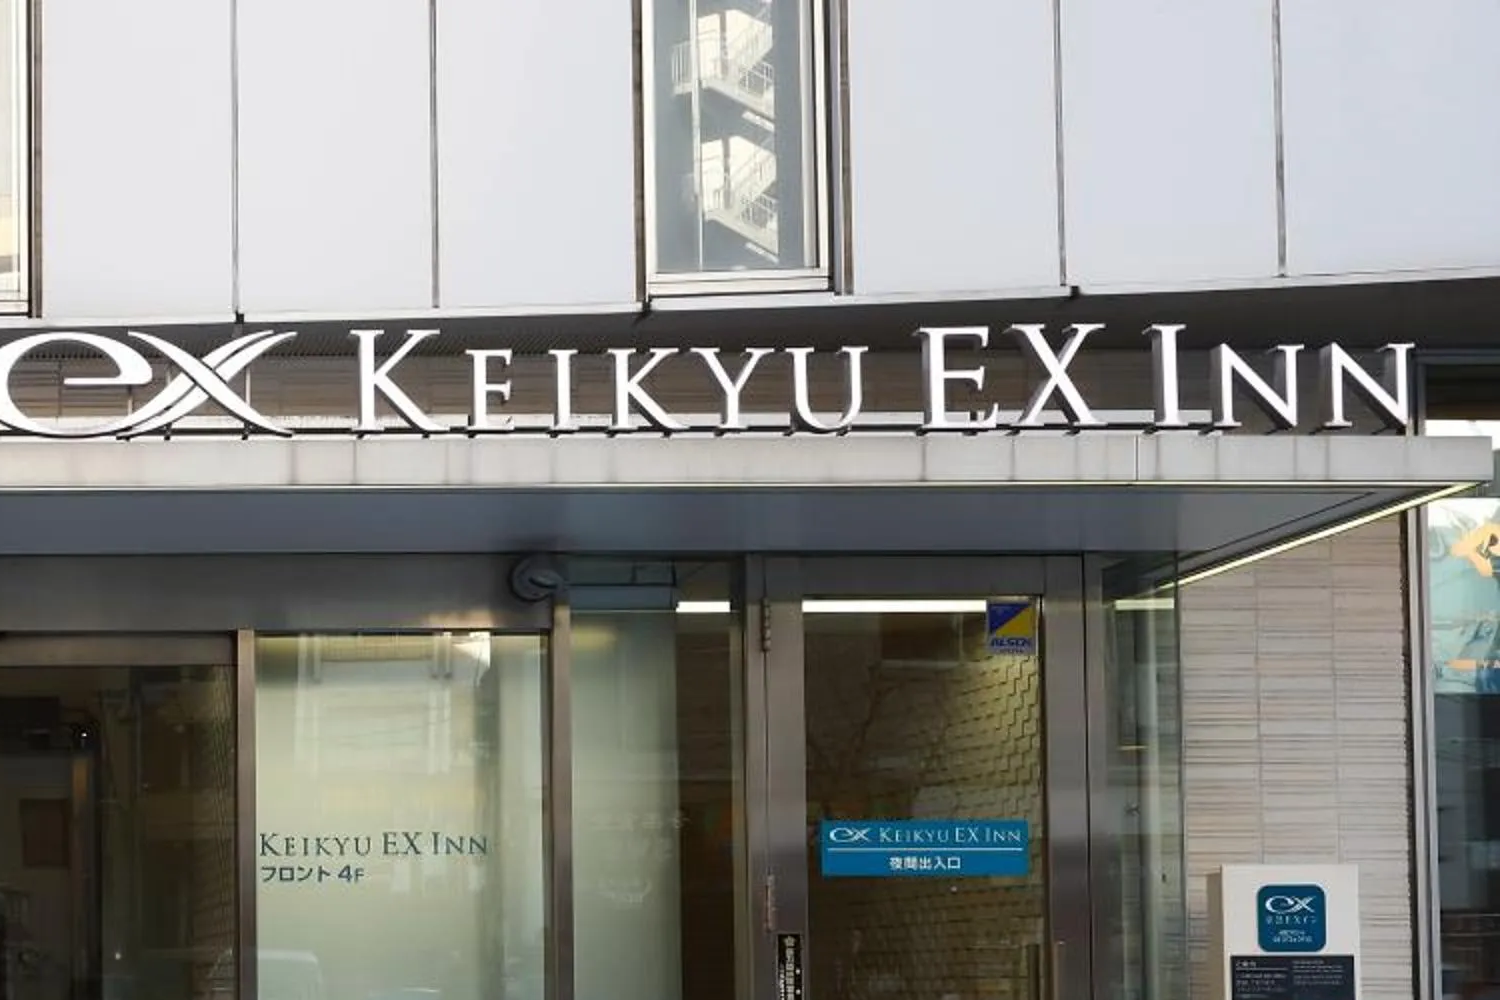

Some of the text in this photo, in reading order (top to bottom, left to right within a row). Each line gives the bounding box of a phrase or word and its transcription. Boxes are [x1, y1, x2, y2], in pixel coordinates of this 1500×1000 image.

[912, 323, 1106, 429] EX
[382, 831, 422, 856] EX
[955, 827, 980, 843] EX
[889, 856, 961, 870] 夜間出入口
[261, 864, 365, 883] フロント 4F
